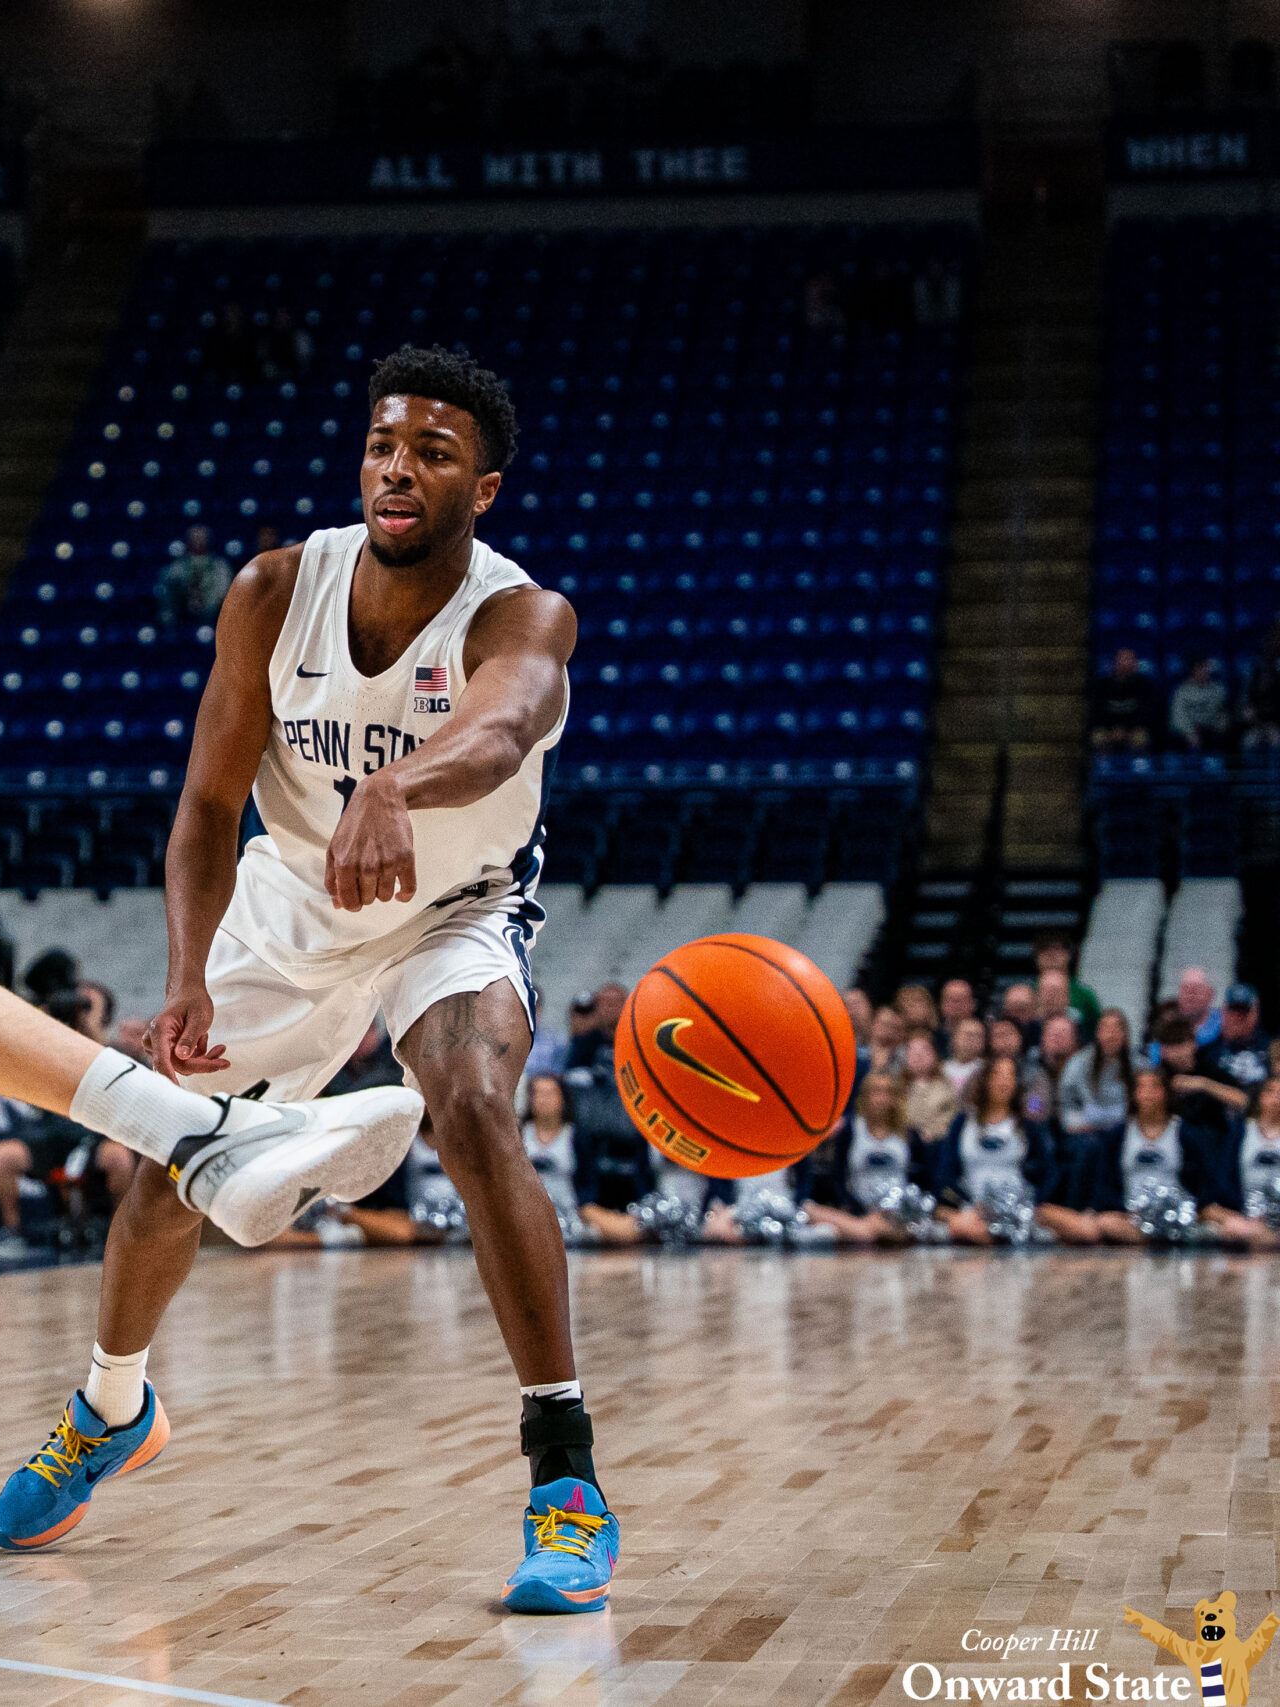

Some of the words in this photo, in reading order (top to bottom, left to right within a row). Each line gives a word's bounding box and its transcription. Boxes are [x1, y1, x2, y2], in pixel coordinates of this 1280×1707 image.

[369, 153, 455, 187] ALL
[482, 150, 602, 185] WITH
[630, 146, 747, 182] THEE
[283, 719, 351, 771] PENN
[363, 723, 427, 775] STA
